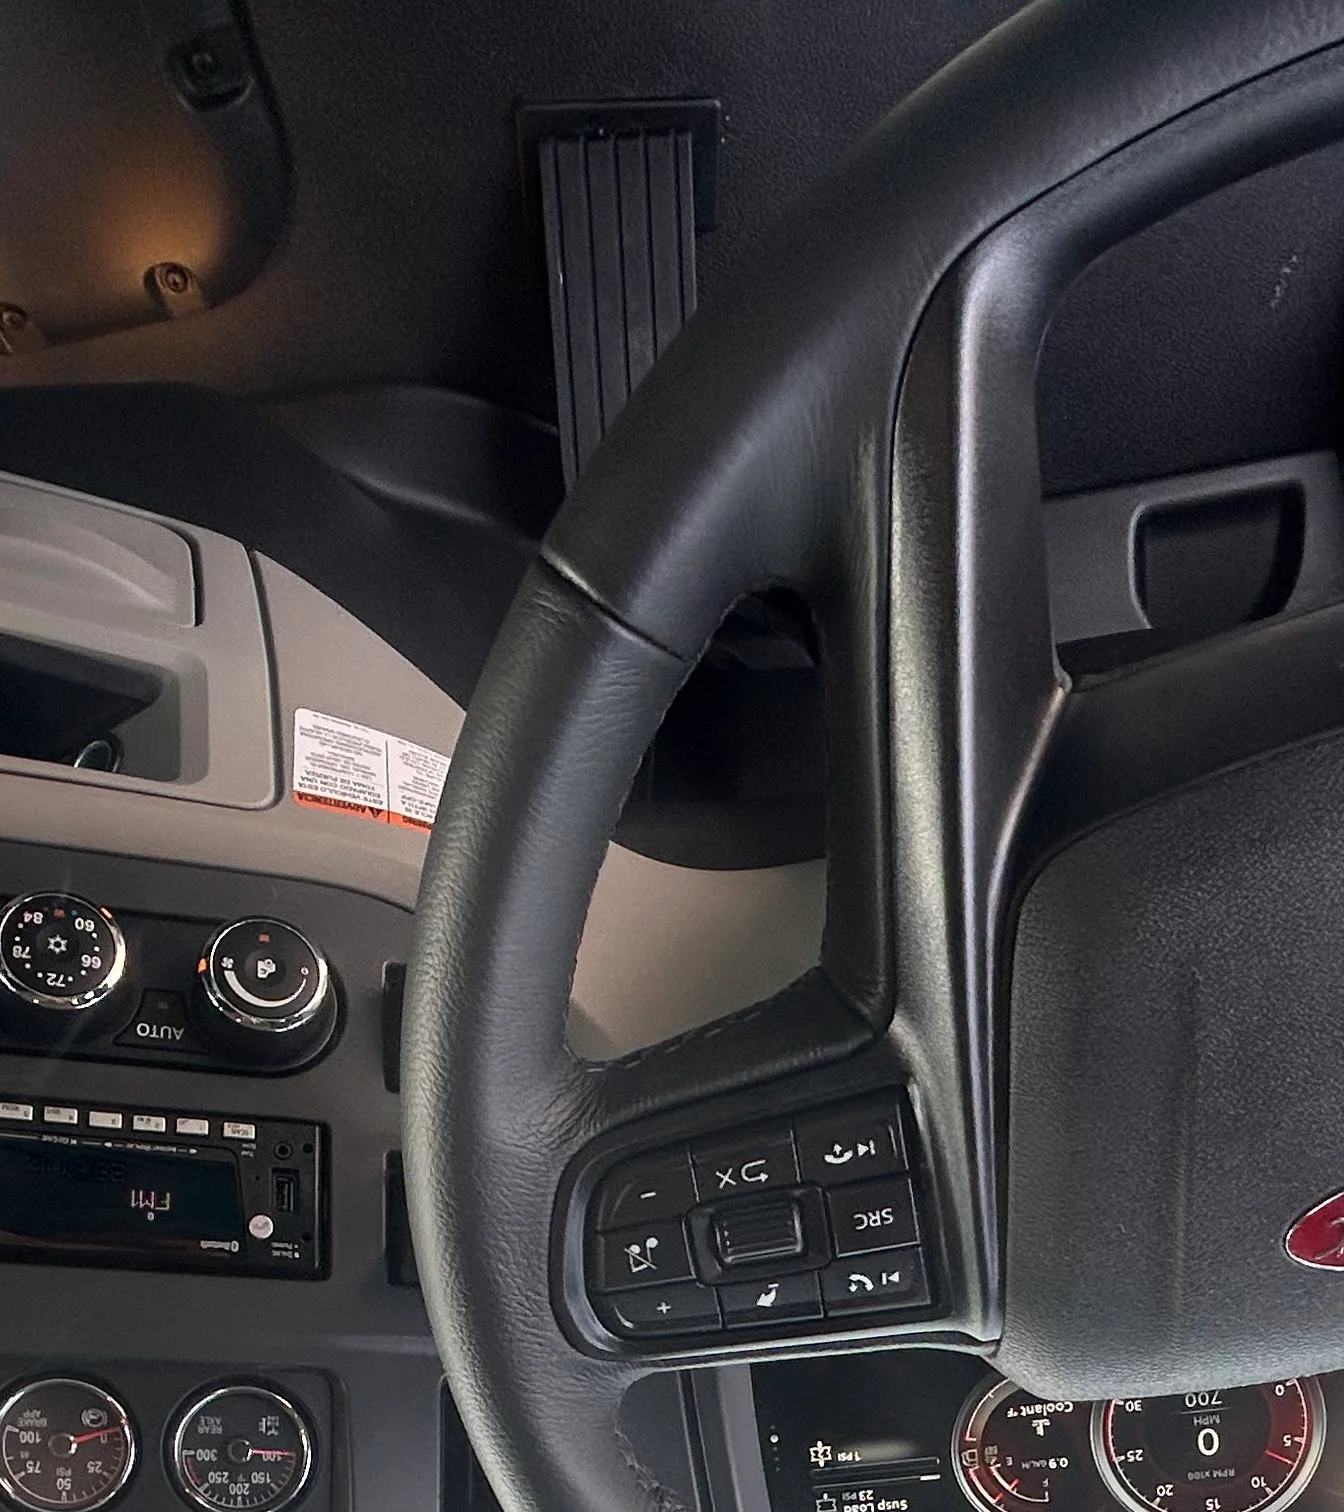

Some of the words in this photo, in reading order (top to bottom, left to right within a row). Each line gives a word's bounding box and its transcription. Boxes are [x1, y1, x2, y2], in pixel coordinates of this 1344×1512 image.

[23, 911, 44, 924] 84
[74, 917, 95, 932] 60
[12, 945, 32, 959] 78
[80, 954, 102, 969] 66
[46, 972, 66, 987] 72
[136, 1022, 185, 1041] AUTO
[130, 1189, 172, 1212] FM1
[851, 1206, 895, 1231] SRC
[1275, 1383, 1285, 1397] 0
[1125, 1400, 1142, 1412] 30
[1184, 1390, 1224, 1409] 700
[1019, 1401, 1074, 1417] Coolant
[200, 1416, 222, 1425] AXLE
[1192, 1414, 1221, 1426] MPH
[198, 1424, 223, 1434] REAR
[18, 1431, 42, 1443] 100
[1197, 1427, 1220, 1457] 0
[1283, 1434, 1292, 1446] 5
[196, 1448, 218, 1461] 300
[837, 1450, 853, 1462] PSI
[1005, 1456, 1012, 1466] E
[1126, 1448, 1144, 1462] 25
[26, 1460, 41, 1473] 75
[87, 1461, 102, 1473] 25
[1048, 1456, 1069, 1469] 0.9
[56, 1466, 72, 1476] PSI
[1187, 1469, 1211, 1482] x100
[1212, 1468, 1235, 1480] RPM
[56, 1477, 72, 1490] 50
[208, 1472, 229, 1484] 250
[251, 1472, 271, 1484] 150
[1250, 1475, 1267, 1488] 10
[228, 1483, 249, 1495] 200
[1156, 1484, 1174, 1497] 20
[841, 1491, 856, 1502] PSI
[877, 1497, 908, 1512] Susp
[1205, 1498, 1221, 1511] 15
